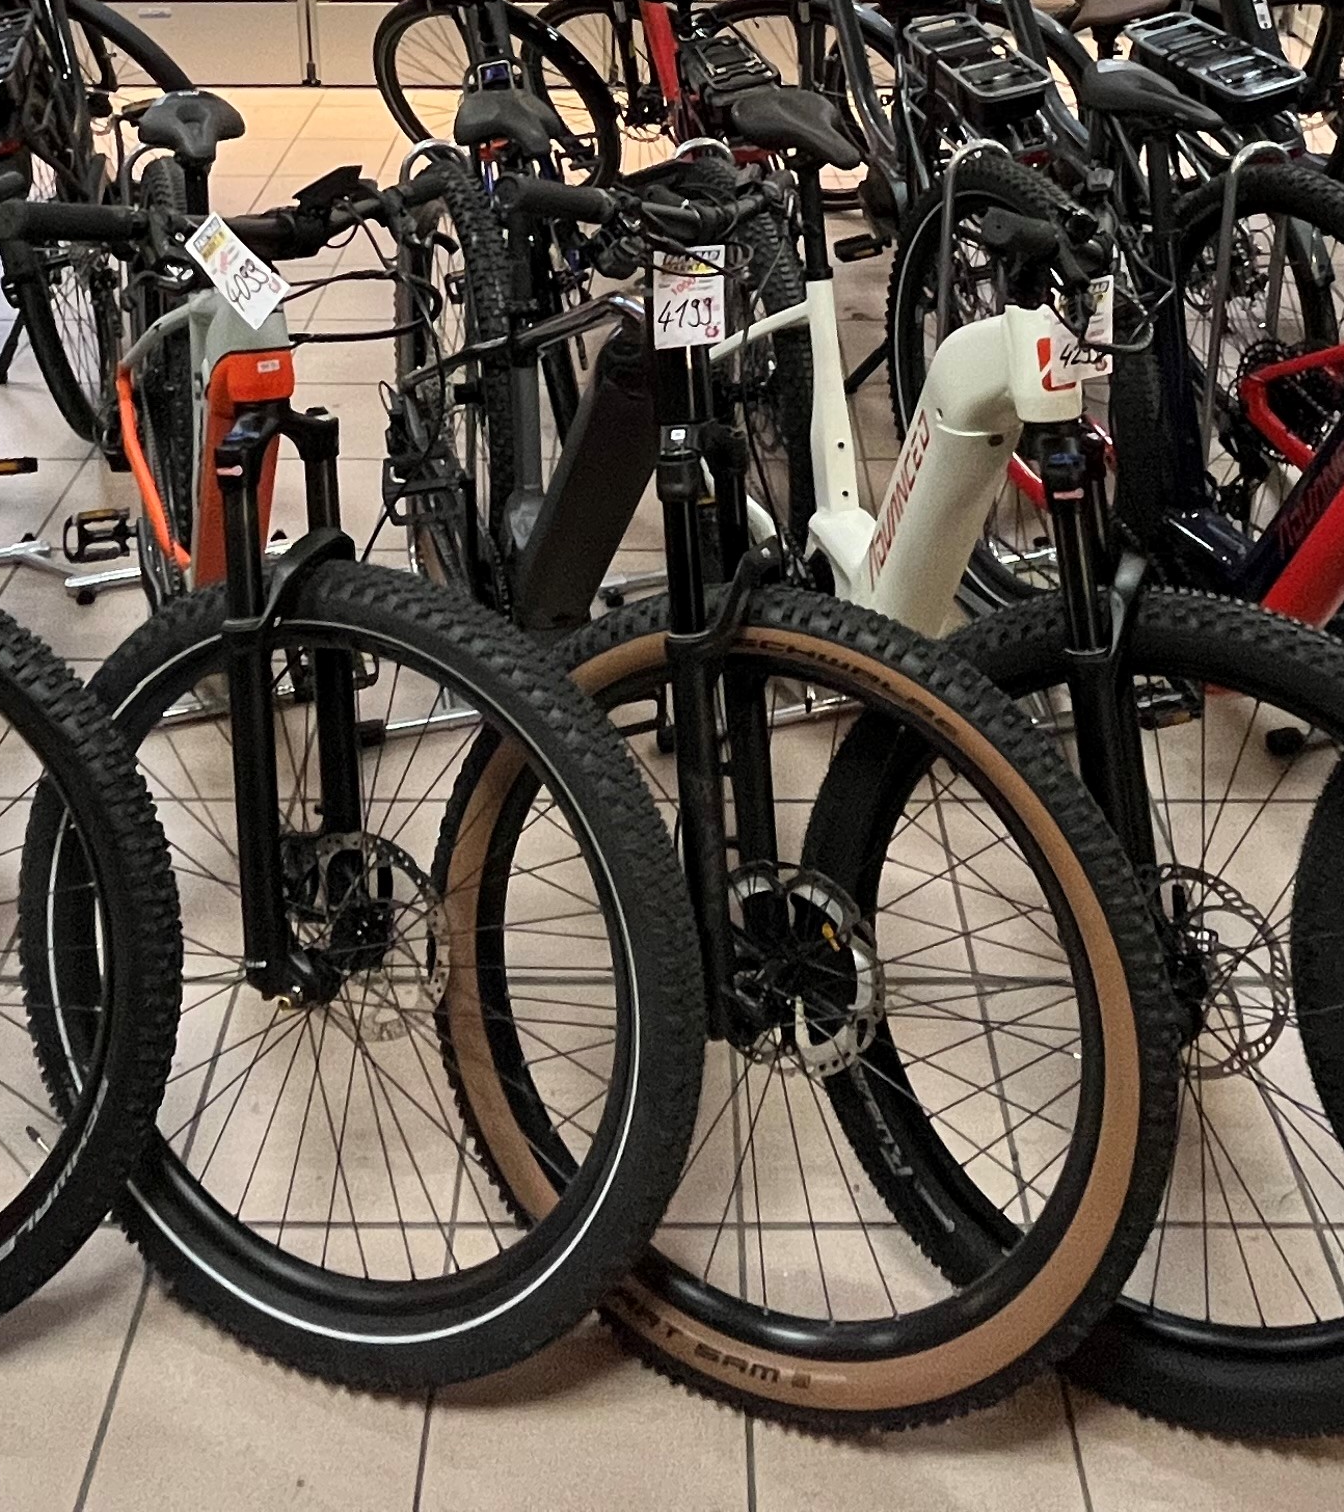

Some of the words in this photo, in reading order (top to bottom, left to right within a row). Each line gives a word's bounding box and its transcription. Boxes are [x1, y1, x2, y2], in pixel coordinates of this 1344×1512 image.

[657, 296, 713, 333] 4199
[868, 407, 931, 593] ADVANCED
[694, 1342, 781, 1384] SAM
